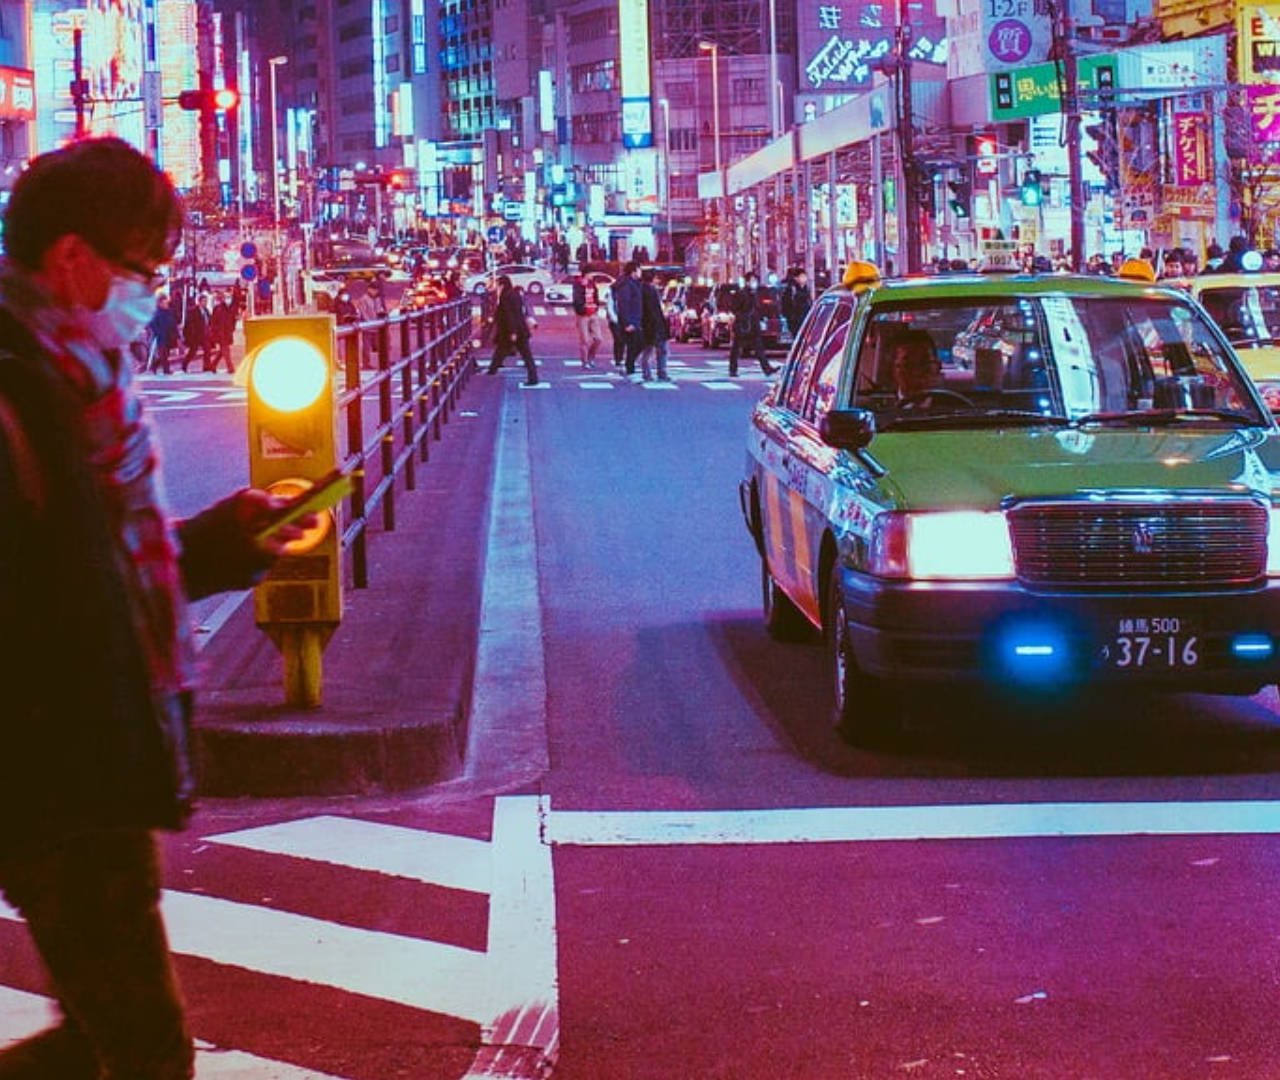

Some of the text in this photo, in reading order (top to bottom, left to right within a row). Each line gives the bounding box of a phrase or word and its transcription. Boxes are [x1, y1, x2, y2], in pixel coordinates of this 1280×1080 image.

[1178, 117, 1196, 181] チケット
[1151, 617, 1180, 634] 500
[1116, 636, 1199, 667] 37-16
